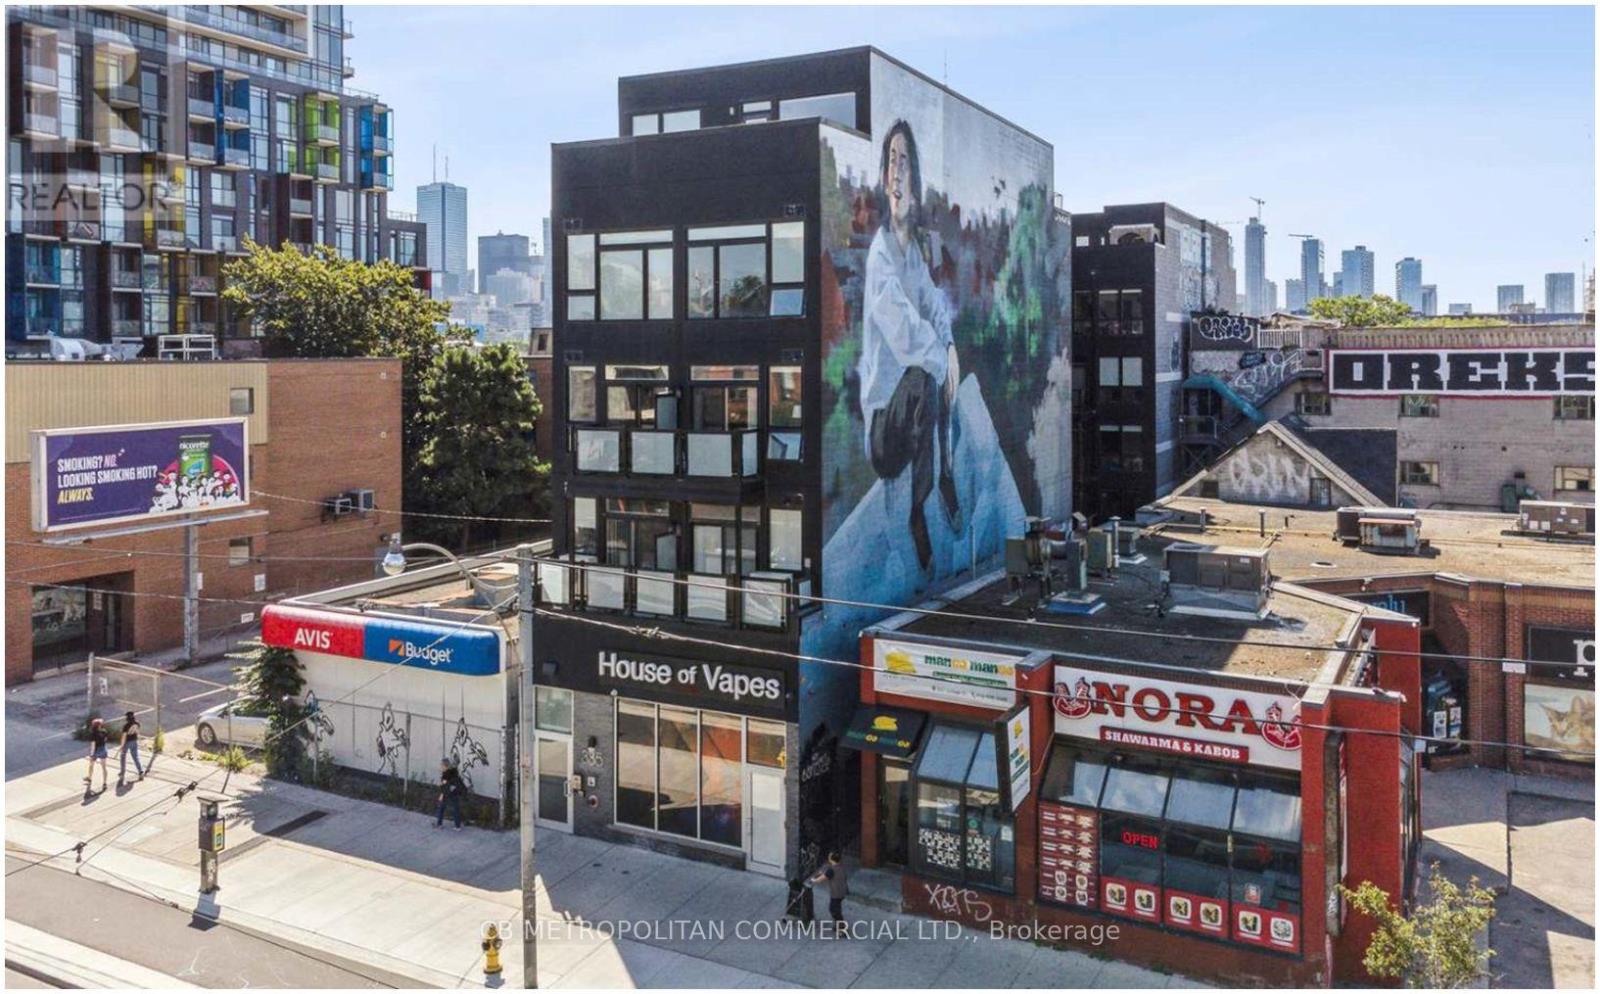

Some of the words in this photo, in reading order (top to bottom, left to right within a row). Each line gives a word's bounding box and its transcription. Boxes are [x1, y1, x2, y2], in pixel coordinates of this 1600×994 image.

[57, 454, 104, 472] SMOKING?
[58, 471, 97, 488] LOOKING
[97, 467, 136, 484] SMOKING
[137, 465, 158, 480] HOT?
[294, 628, 331, 649] AVIS
[405, 641, 451, 665] Budget
[598, 651, 672, 684] House
[677, 666, 697, 685] of
[702, 664, 780, 700] Vapes
[1091, 681, 1262, 736] NORA
[1105, 730, 1181, 752] SHAWARMA
[1182, 740, 1192, 752] &
[1194, 743, 1241, 760] KABOB
[1122, 831, 1160, 849] OPEN
